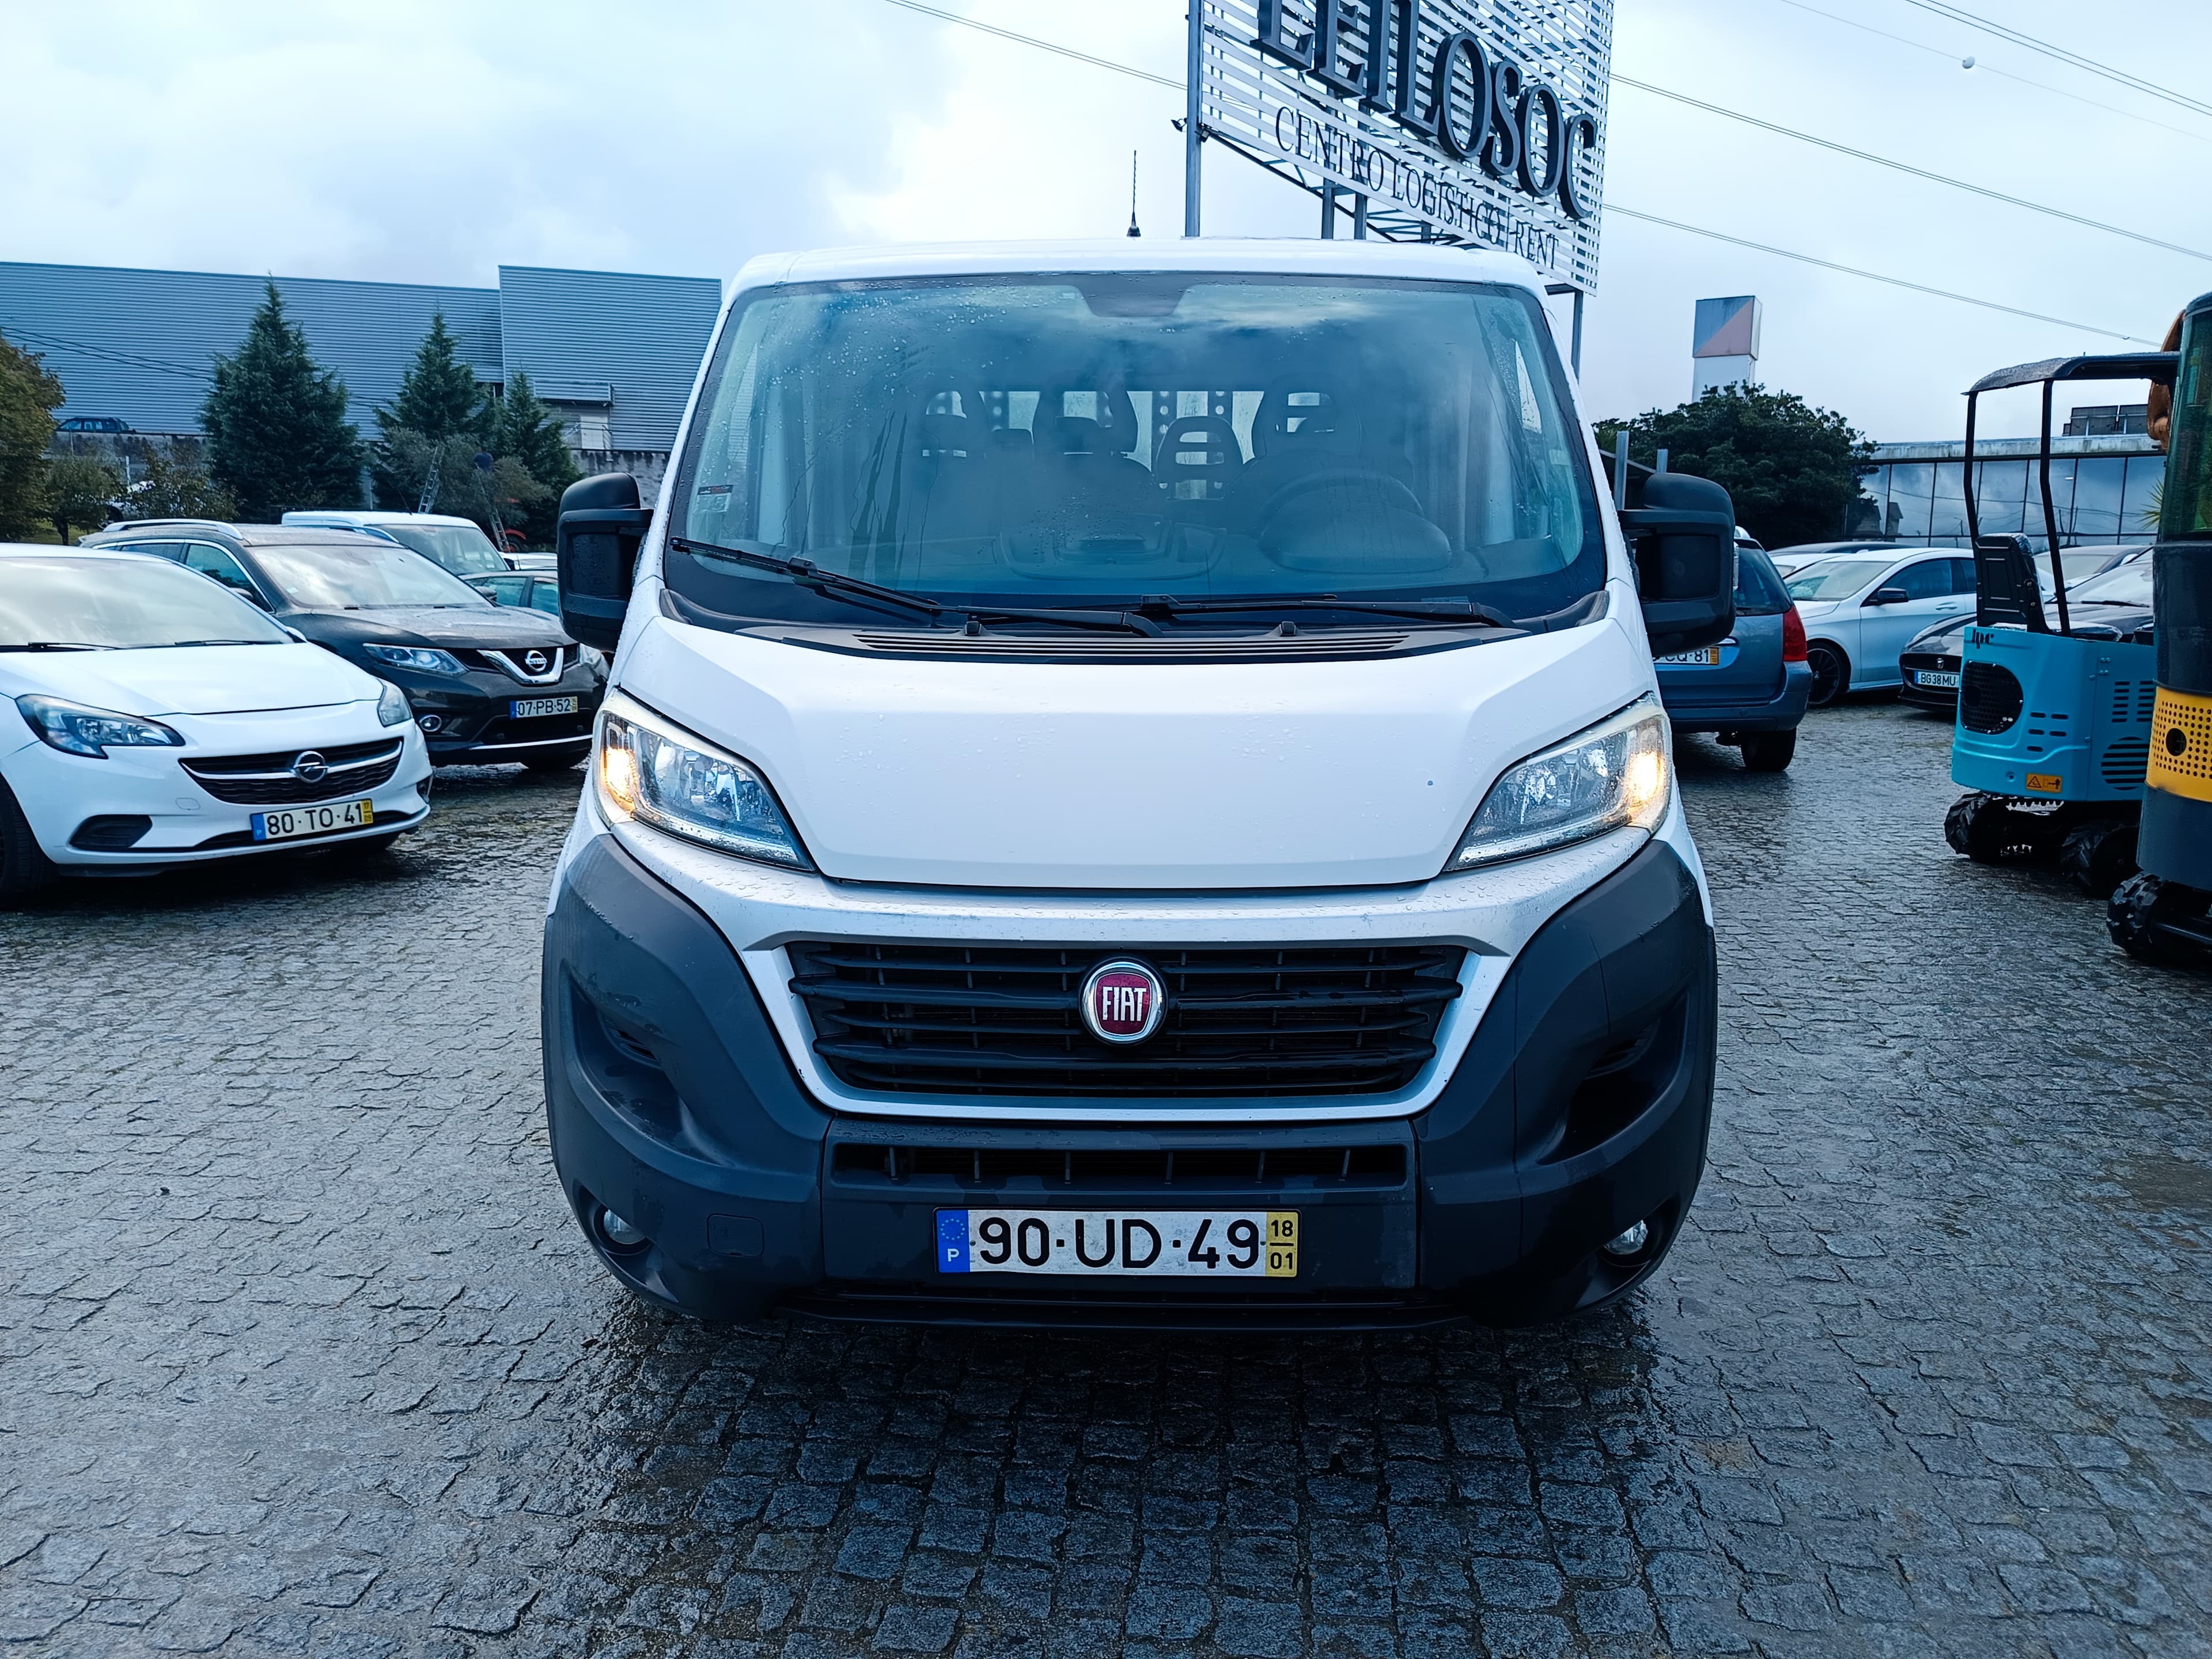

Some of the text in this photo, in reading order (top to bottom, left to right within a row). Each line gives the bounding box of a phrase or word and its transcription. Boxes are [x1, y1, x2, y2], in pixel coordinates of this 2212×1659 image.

[1275, 106, 1384, 192] CENTRO
[1514, 219, 1559, 270] RENT
[1921, 673, 1956, 686] BG38MU
[1103, 986, 1147, 1021] FIAT
[1271, 1219, 1294, 1237] 18
[947, 1248, 960, 1262] P
[1270, 1252, 1293, 1270] 01
